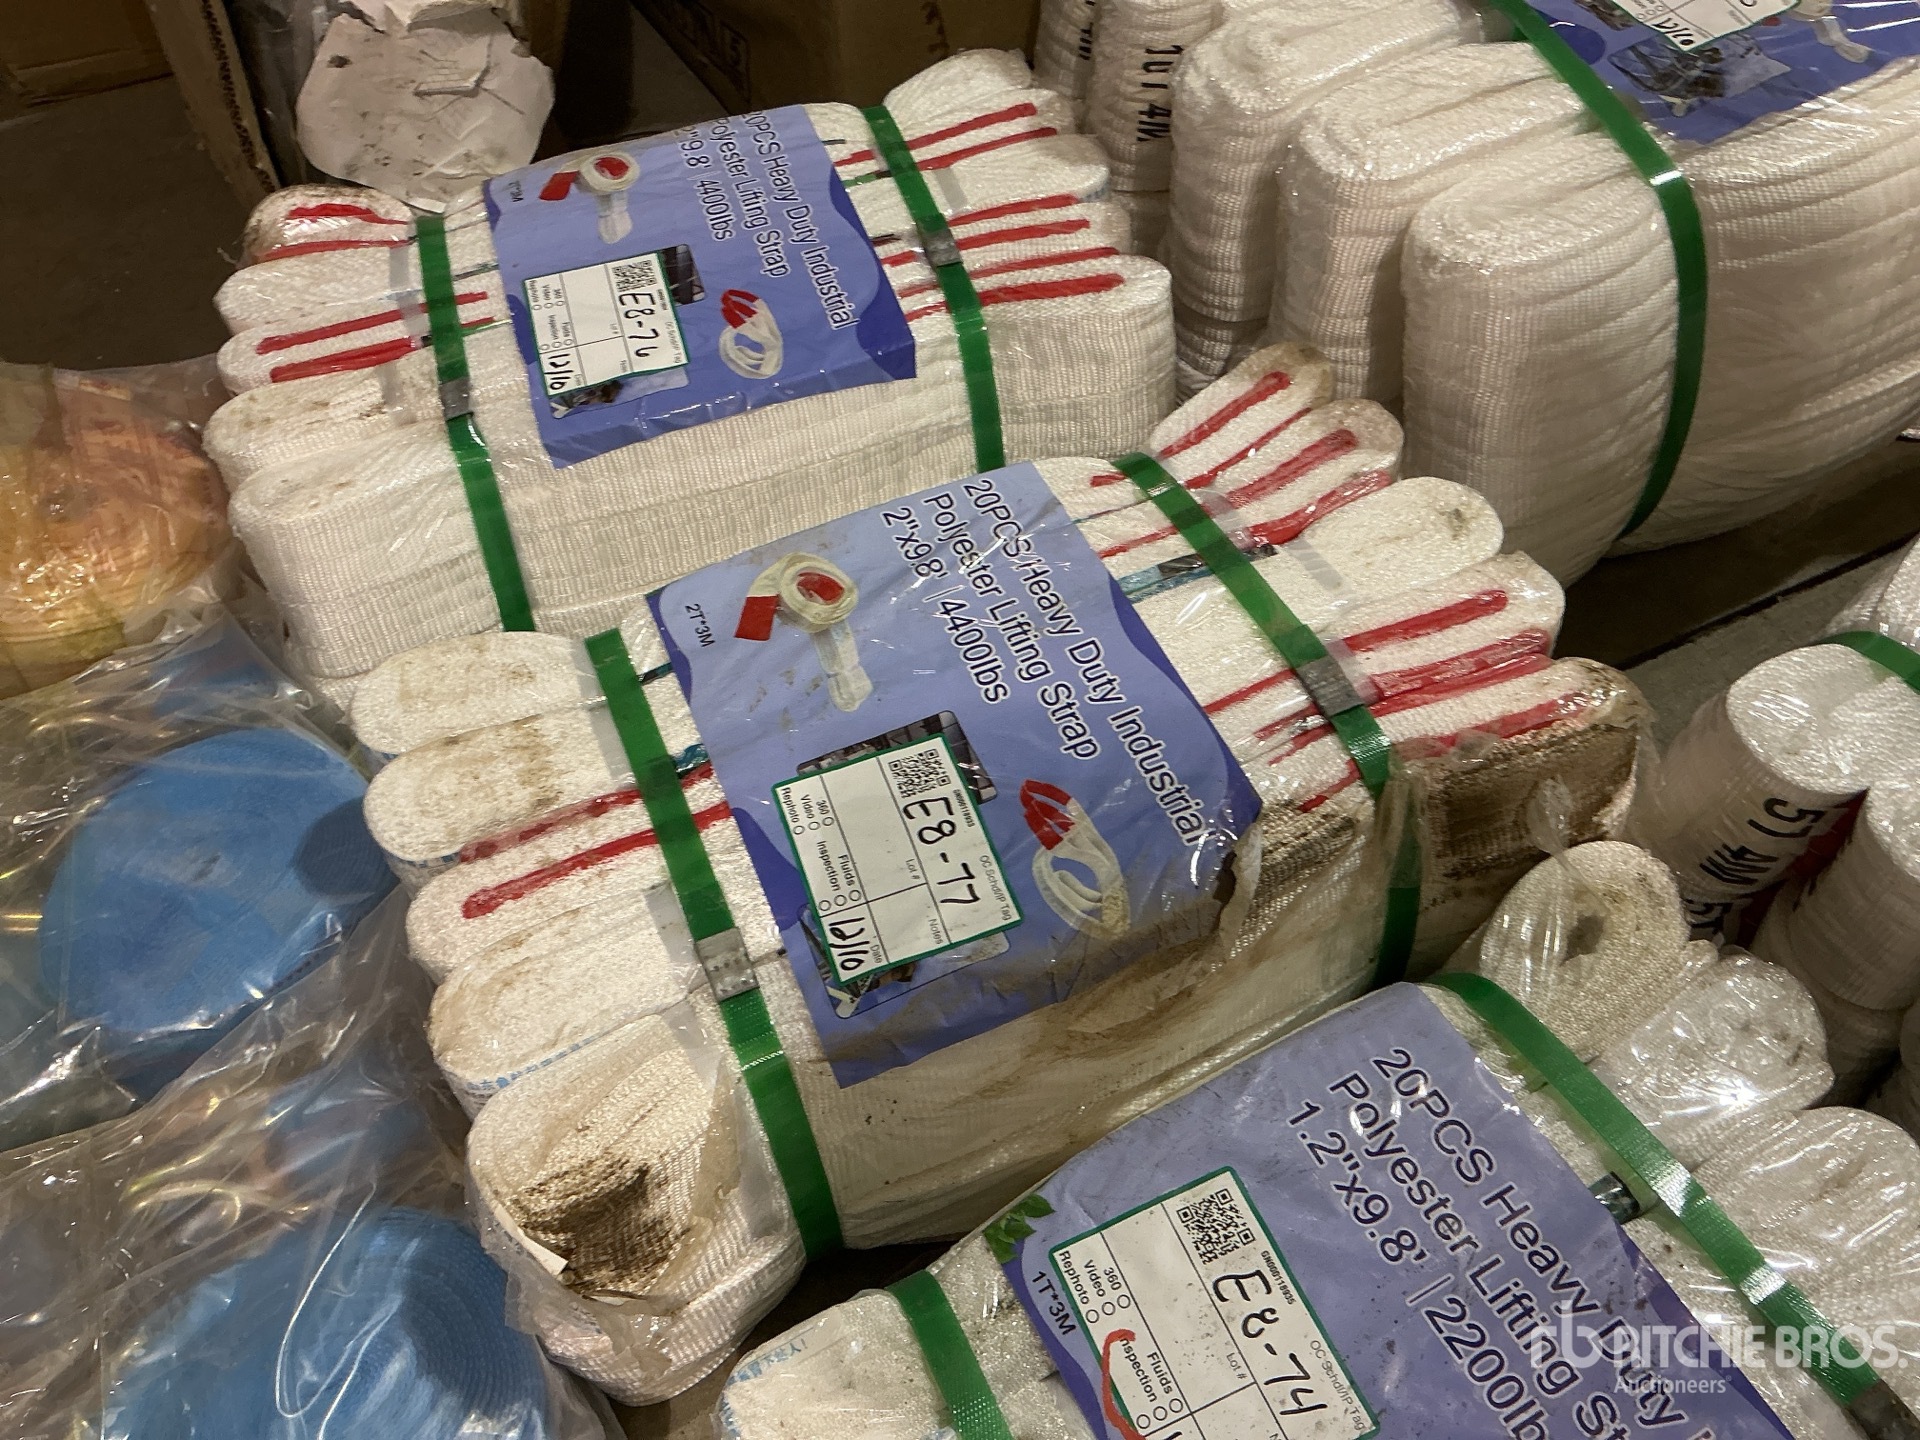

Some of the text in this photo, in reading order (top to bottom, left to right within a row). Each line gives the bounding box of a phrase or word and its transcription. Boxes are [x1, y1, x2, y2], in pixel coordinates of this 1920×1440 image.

[696, 180, 736, 240] 4400lbs
[709, 117, 789, 277] Polyester Lifting Strap
[763, 155, 800, 202] Heavy
[786, 205, 817, 244] Duty
[803, 247, 859, 330] Industrial
[618, 292, 660, 358] E8-76
[924, 492, 1099, 759] Polyester Lifting Strap
[938, 599, 1010, 703] 4400lbs
[963, 479, 1216, 846] 20PCS Heavy Duty Industrial
[781, 787, 800, 823] Rephoto
[800, 794, 815, 819] Video
[815, 799, 830, 815] 360
[816, 841, 841, 891] Inspection
[838, 854, 856, 886] Fluids
[903, 796, 981, 904] E8-77
[905, 858, 916, 874] Lot
[979, 855, 992, 869] OC
[1000, 903, 1013, 921] Tag
[828, 917, 870, 971] 12/10
[870, 944, 883, 964] Date
[928, 918, 944, 945] Notes
[1329, 1072, 1580, 1395] Polyester Lifting
[1371, 1048, 1494, 1183] 20PCS
[1482, 1185, 1599, 1315] Heavy
[1598, 1318, 1687, 1426] Duty
[1059, 1250, 1090, 1305] Rephoto
[1083, 1259, 1106, 1298] Video
[1103, 1267, 1122, 1291] 360
[1119, 1337, 1158, 1403] nspection
[1212, 1269, 1328, 1415] E8-74
[1226, 1352, 1241, 1372] Lot
[1260, 1250, 1297, 1305] GN000118935
[1309, 1339, 1327, 1360] OC
[1348, 1407, 1367, 1431] Tag
[1424, 1297, 1547, 1440] 2200lb
[1147, 1351, 1173, 1395] Fluids
